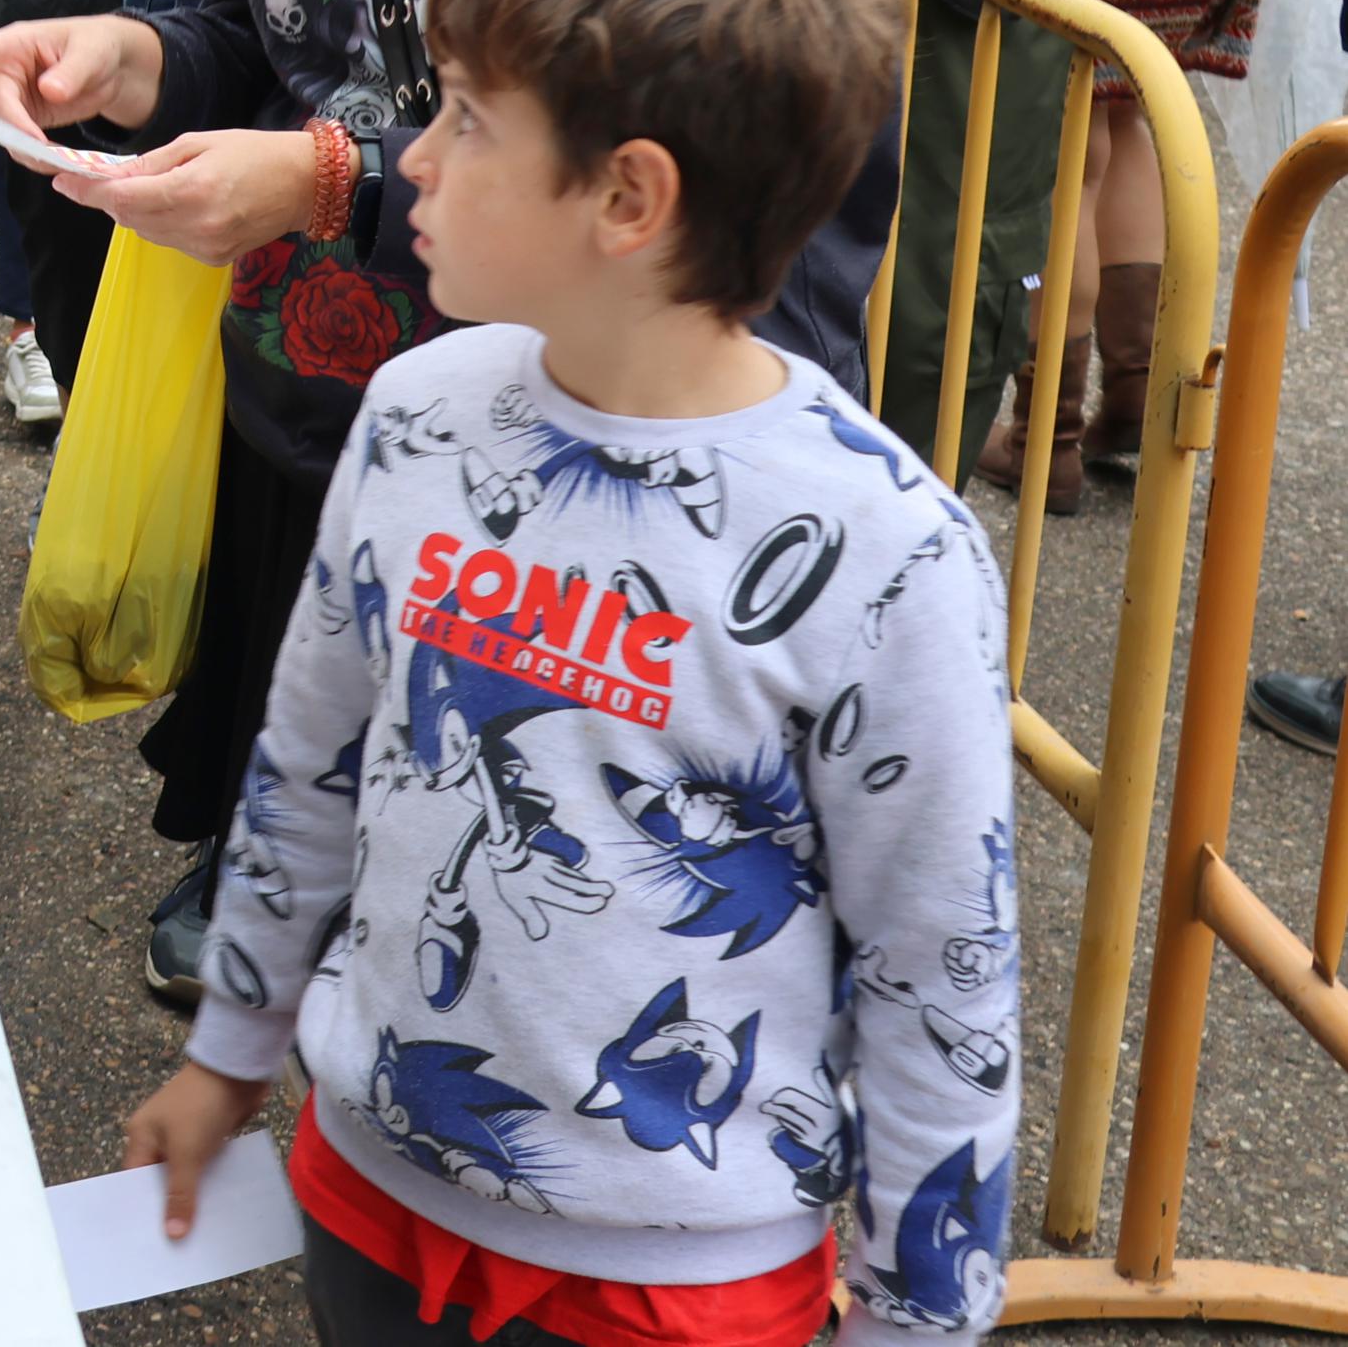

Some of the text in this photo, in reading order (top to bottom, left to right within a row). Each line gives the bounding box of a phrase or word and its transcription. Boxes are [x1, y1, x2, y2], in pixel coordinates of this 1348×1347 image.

[404, 605, 666, 723] THE HEDGEHOG
[410, 532, 693, 687] SONIC
